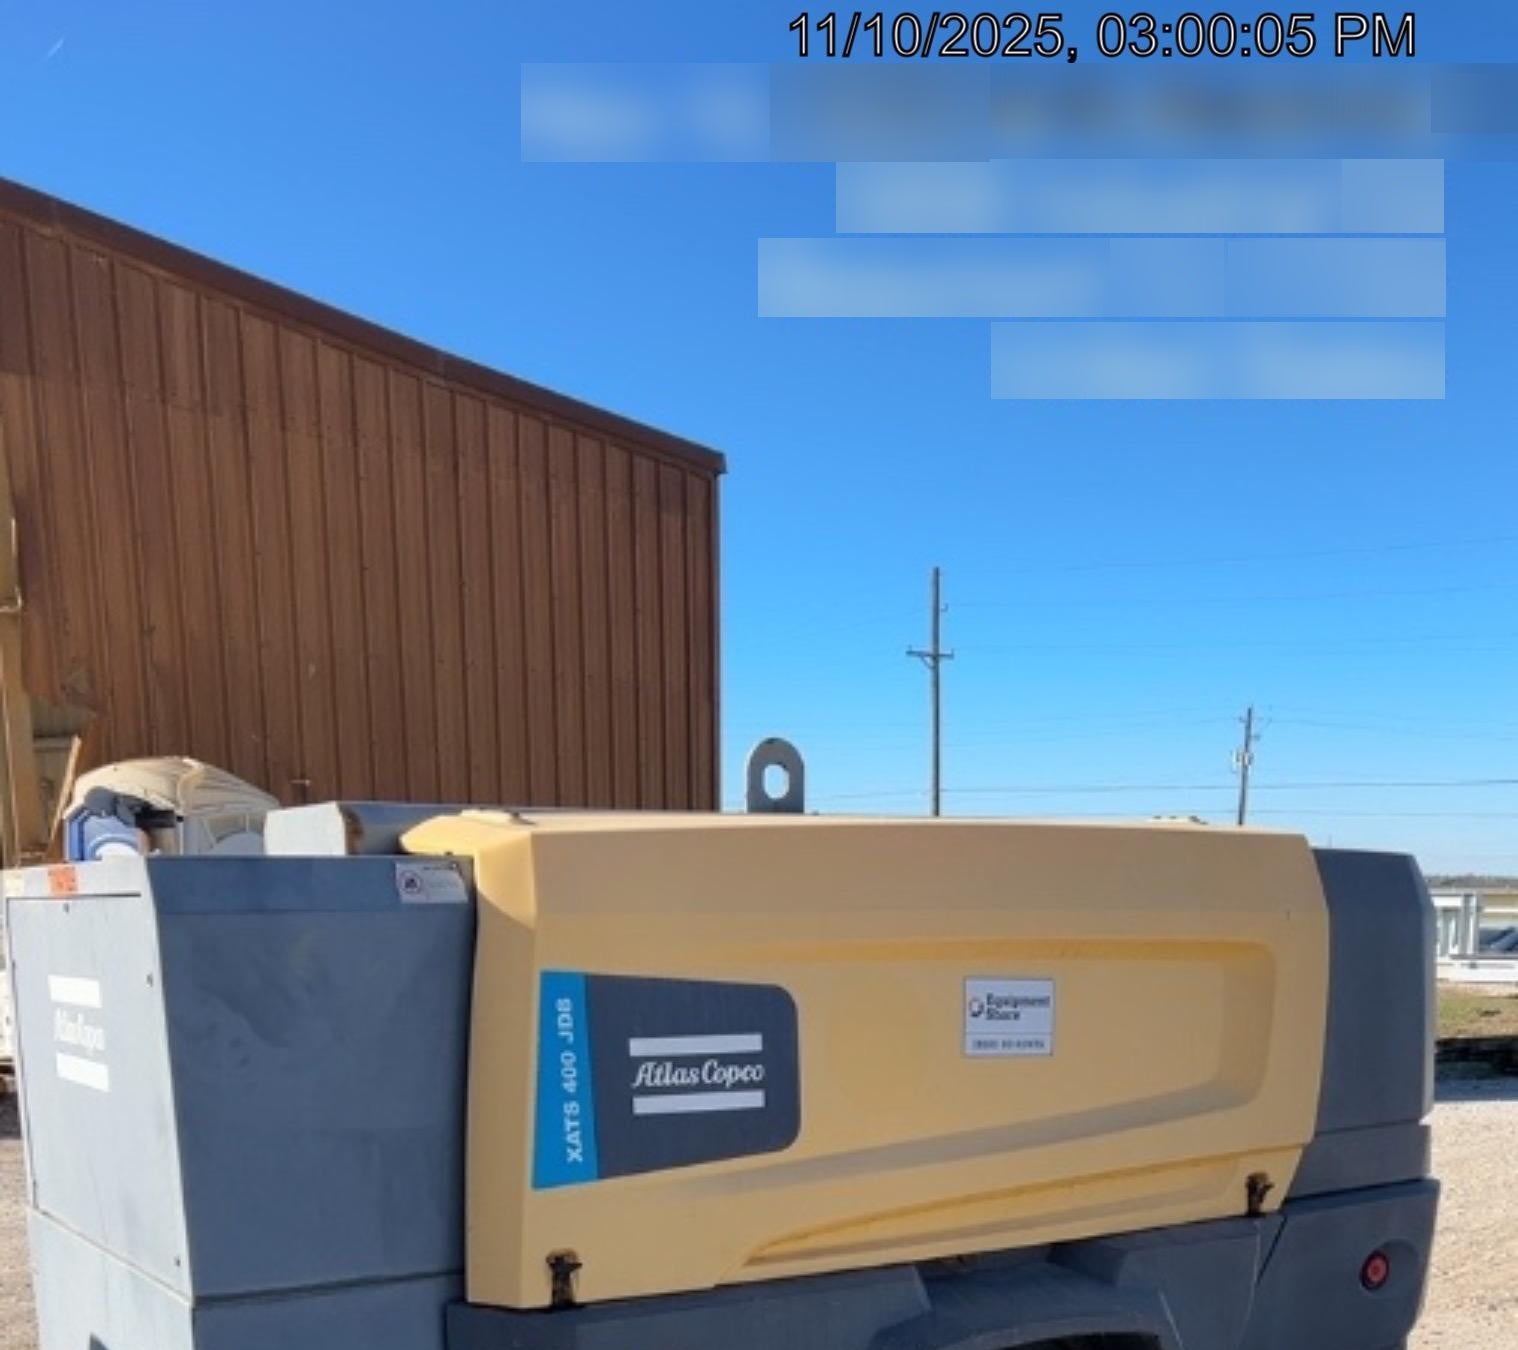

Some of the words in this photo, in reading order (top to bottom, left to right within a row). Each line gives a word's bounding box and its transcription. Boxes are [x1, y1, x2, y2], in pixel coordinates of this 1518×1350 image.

[560, 1051, 578, 1093] 400
[630, 1060, 700, 1089] Atlas
[701, 1058, 766, 1088] Copco
[563, 1100, 584, 1163] XATS
